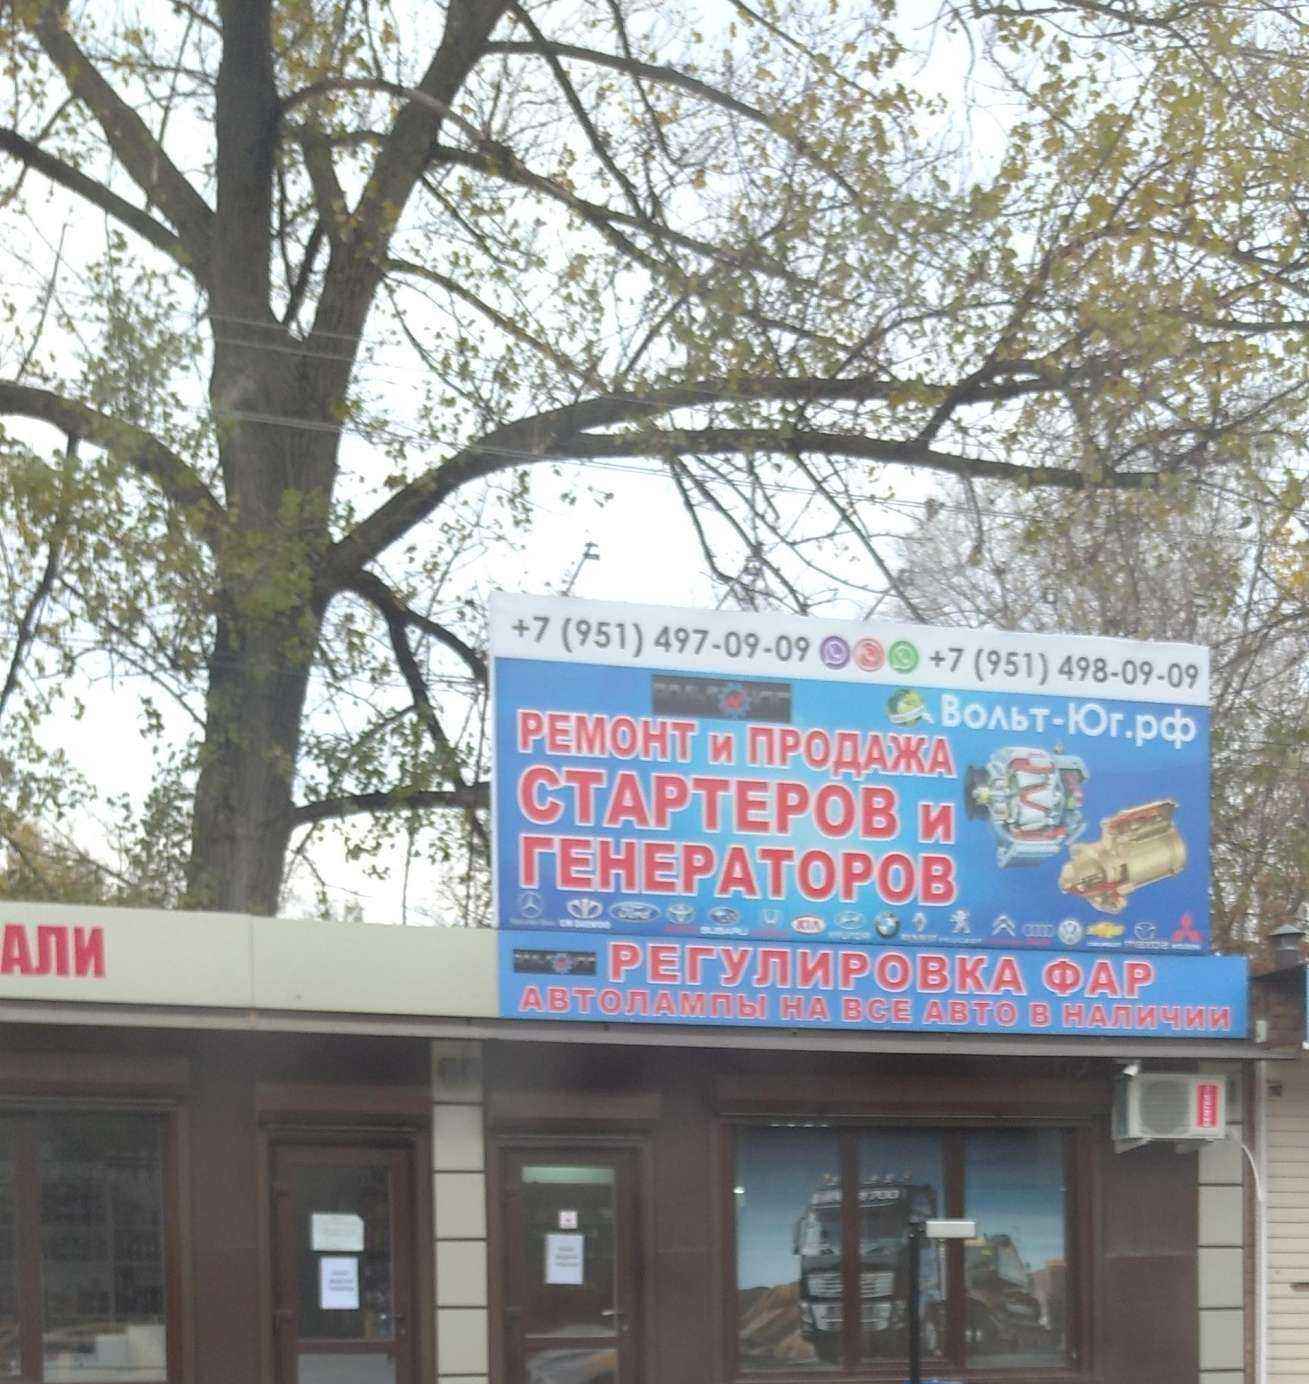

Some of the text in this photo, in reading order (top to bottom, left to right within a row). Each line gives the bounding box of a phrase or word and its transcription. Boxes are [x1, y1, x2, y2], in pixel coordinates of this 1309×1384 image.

[512, 617, 811, 662] +7 (951) 497-09-09
[930, 648, 1199, 690] +7 (951) 498-09-09
[517, 709, 957, 779] РЕМОНТ и ПРОДАЖА
[940, 694, 1196, 749] Вольт-Юг.рф
[518, 765, 900, 841] СТАРТЕРОВ
[517, 833, 957, 906] ГЕНЕРАТОРОВ
[607, 941, 1155, 998] РЕГУЛИРОВКА ФАР
[518, 985, 1232, 1030] АВТОЛАМПЫ НА ВСЕ АВТО В НАЛИЧИИ
